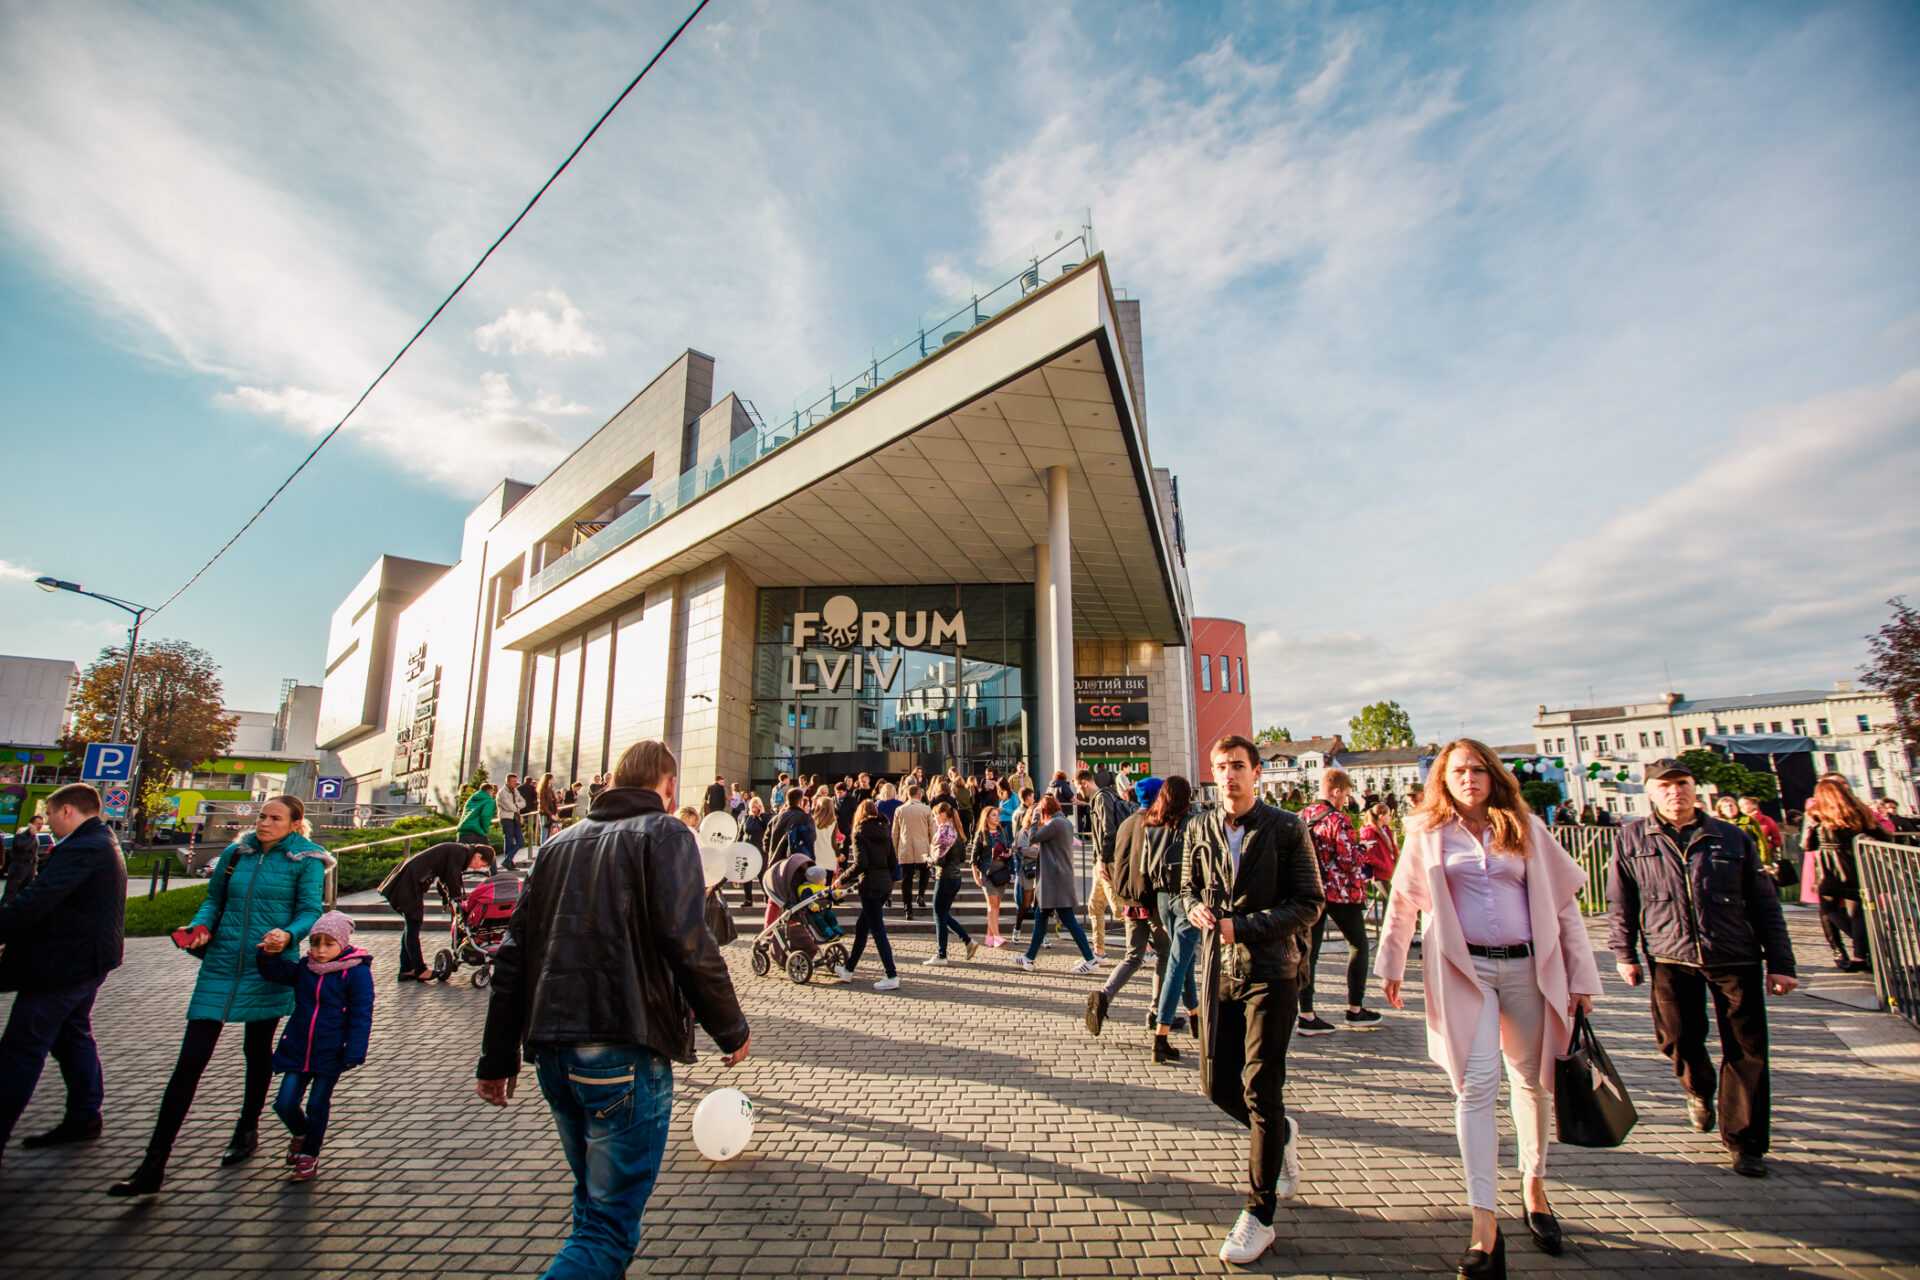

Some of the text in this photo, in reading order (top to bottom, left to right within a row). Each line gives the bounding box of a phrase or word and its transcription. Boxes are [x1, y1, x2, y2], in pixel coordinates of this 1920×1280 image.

[792, 654, 902, 690] LVIV
[1074, 677, 1121, 689] ОЛОТИЙ
[1089, 704, 1121, 717] CCC
[96, 748, 124, 777] P
[323, 784, 335, 798] P
